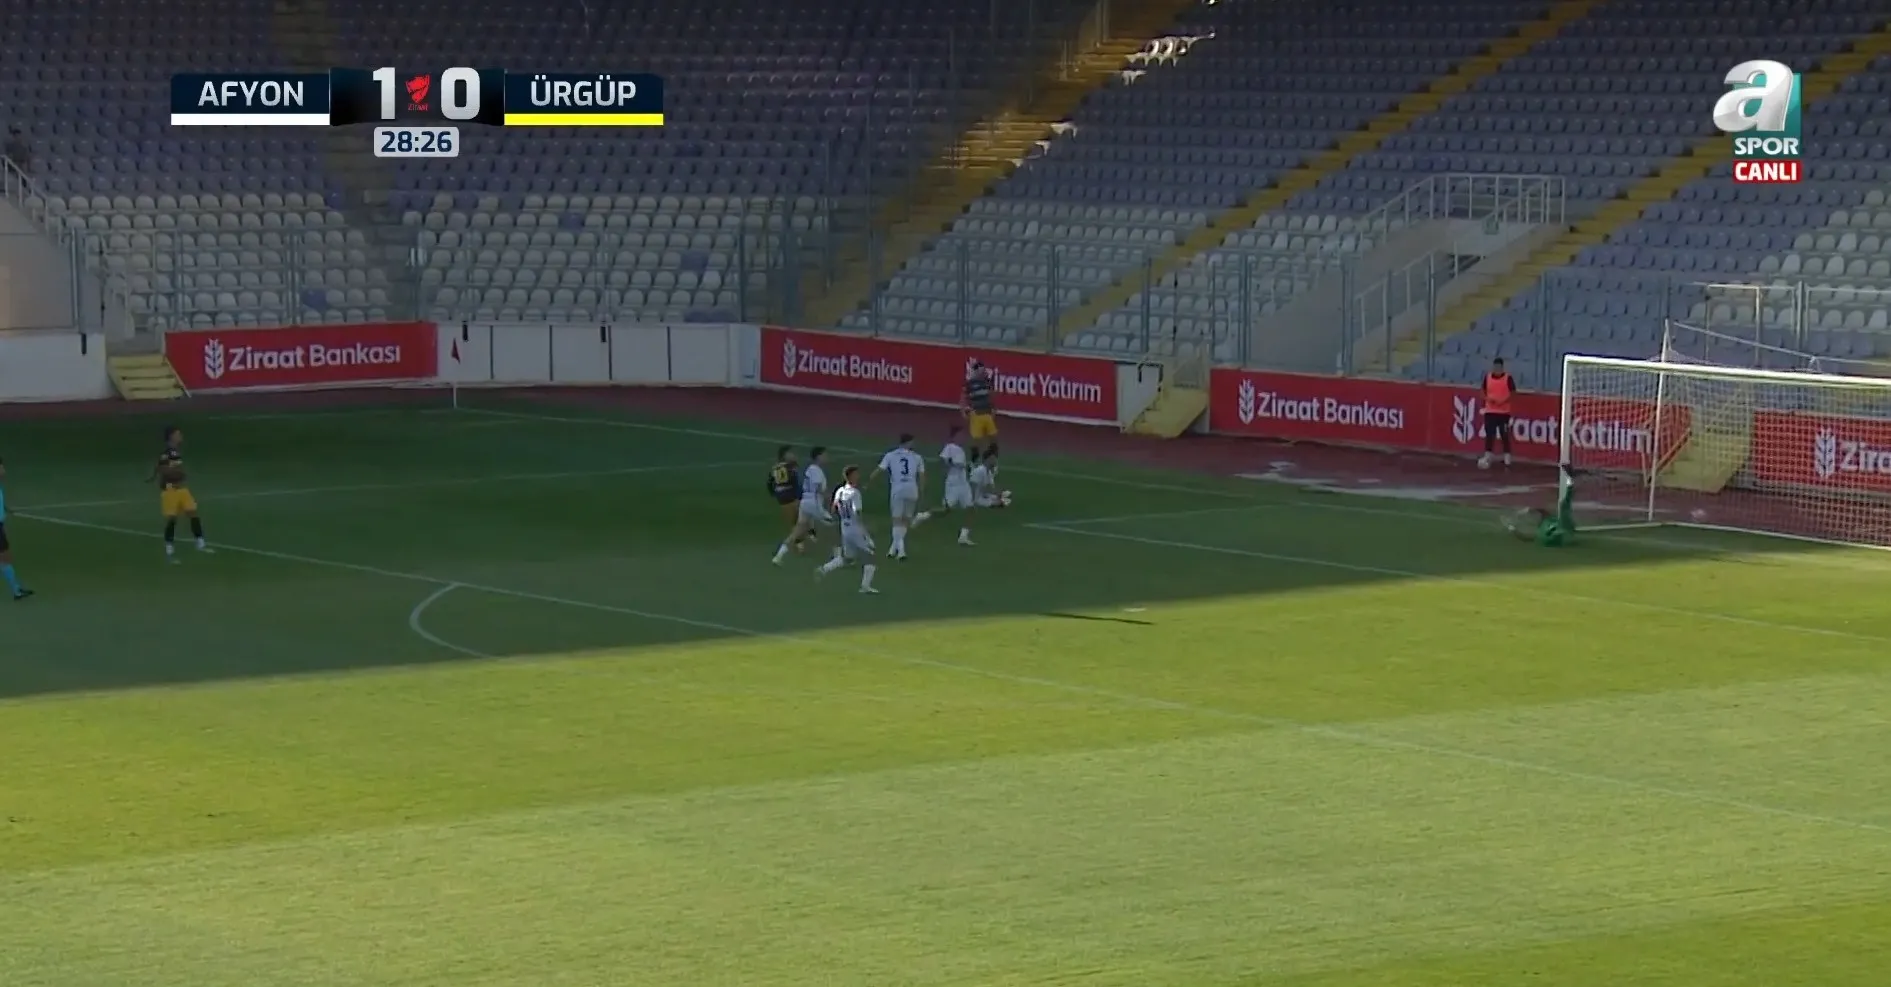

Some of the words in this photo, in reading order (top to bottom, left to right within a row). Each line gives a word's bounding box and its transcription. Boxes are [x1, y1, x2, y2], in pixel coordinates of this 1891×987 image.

[228, 346, 305, 371] Ziraat
[309, 342, 401, 367] Bankası
[798, 349, 848, 376] Ziraat
[850, 354, 913, 383] Bankası
[1257, 391, 1321, 422] Ziraat
[1323, 398, 1404, 429] Bankası
[900, 457, 909, 475] 3
